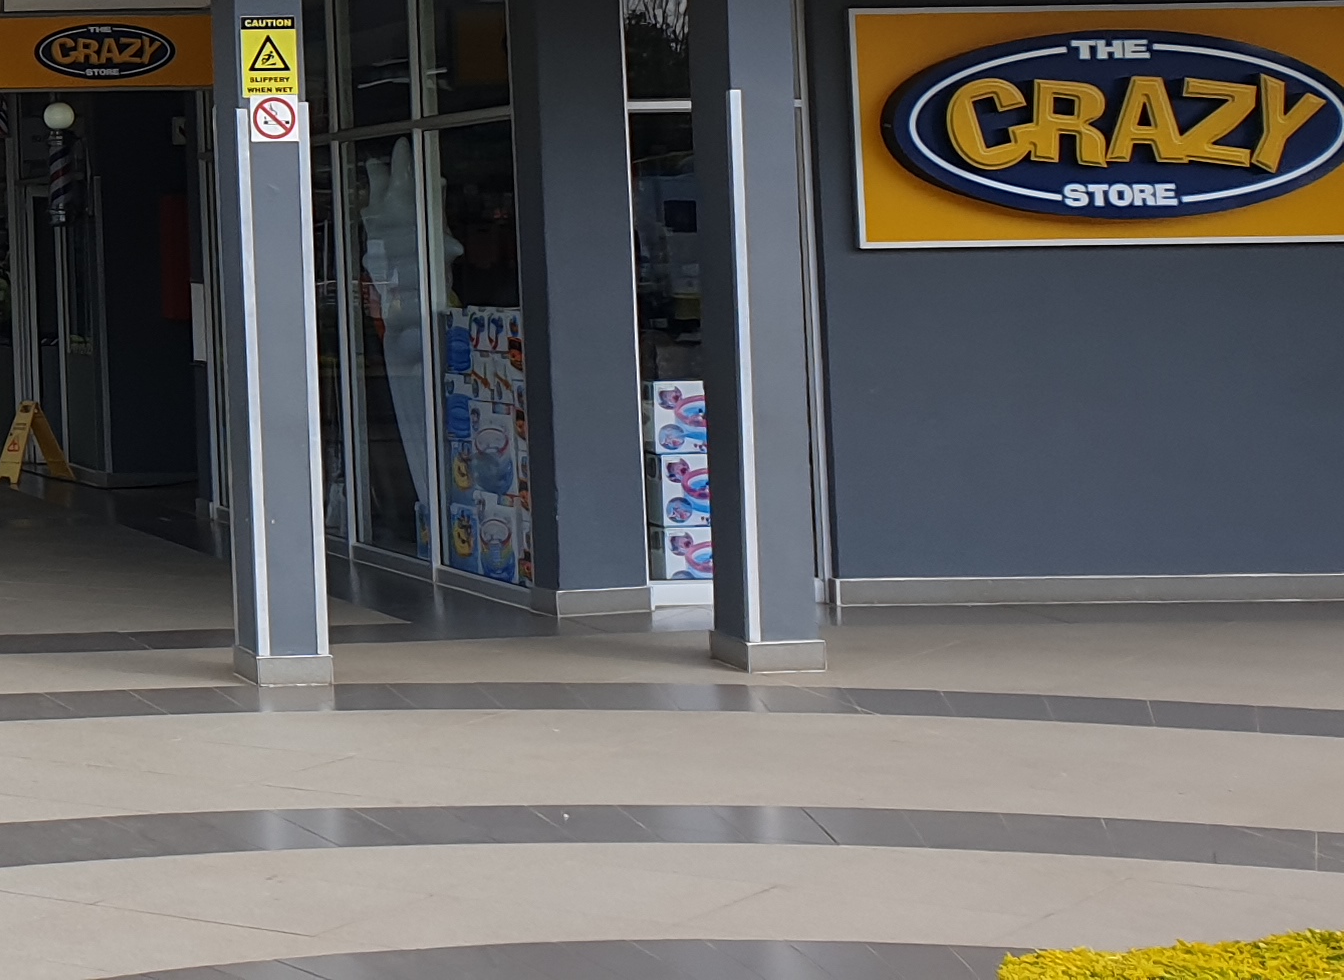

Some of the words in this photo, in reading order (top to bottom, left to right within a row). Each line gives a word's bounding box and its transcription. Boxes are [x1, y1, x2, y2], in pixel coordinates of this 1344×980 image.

[244, 19, 292, 27] CAUTION
[51, 35, 162, 65] CRAZY
[1070, 39, 1151, 60] THE
[85, 68, 120, 76] STORE
[946, 72, 1326, 174] CRAZY
[1063, 183, 1180, 208] STORE
